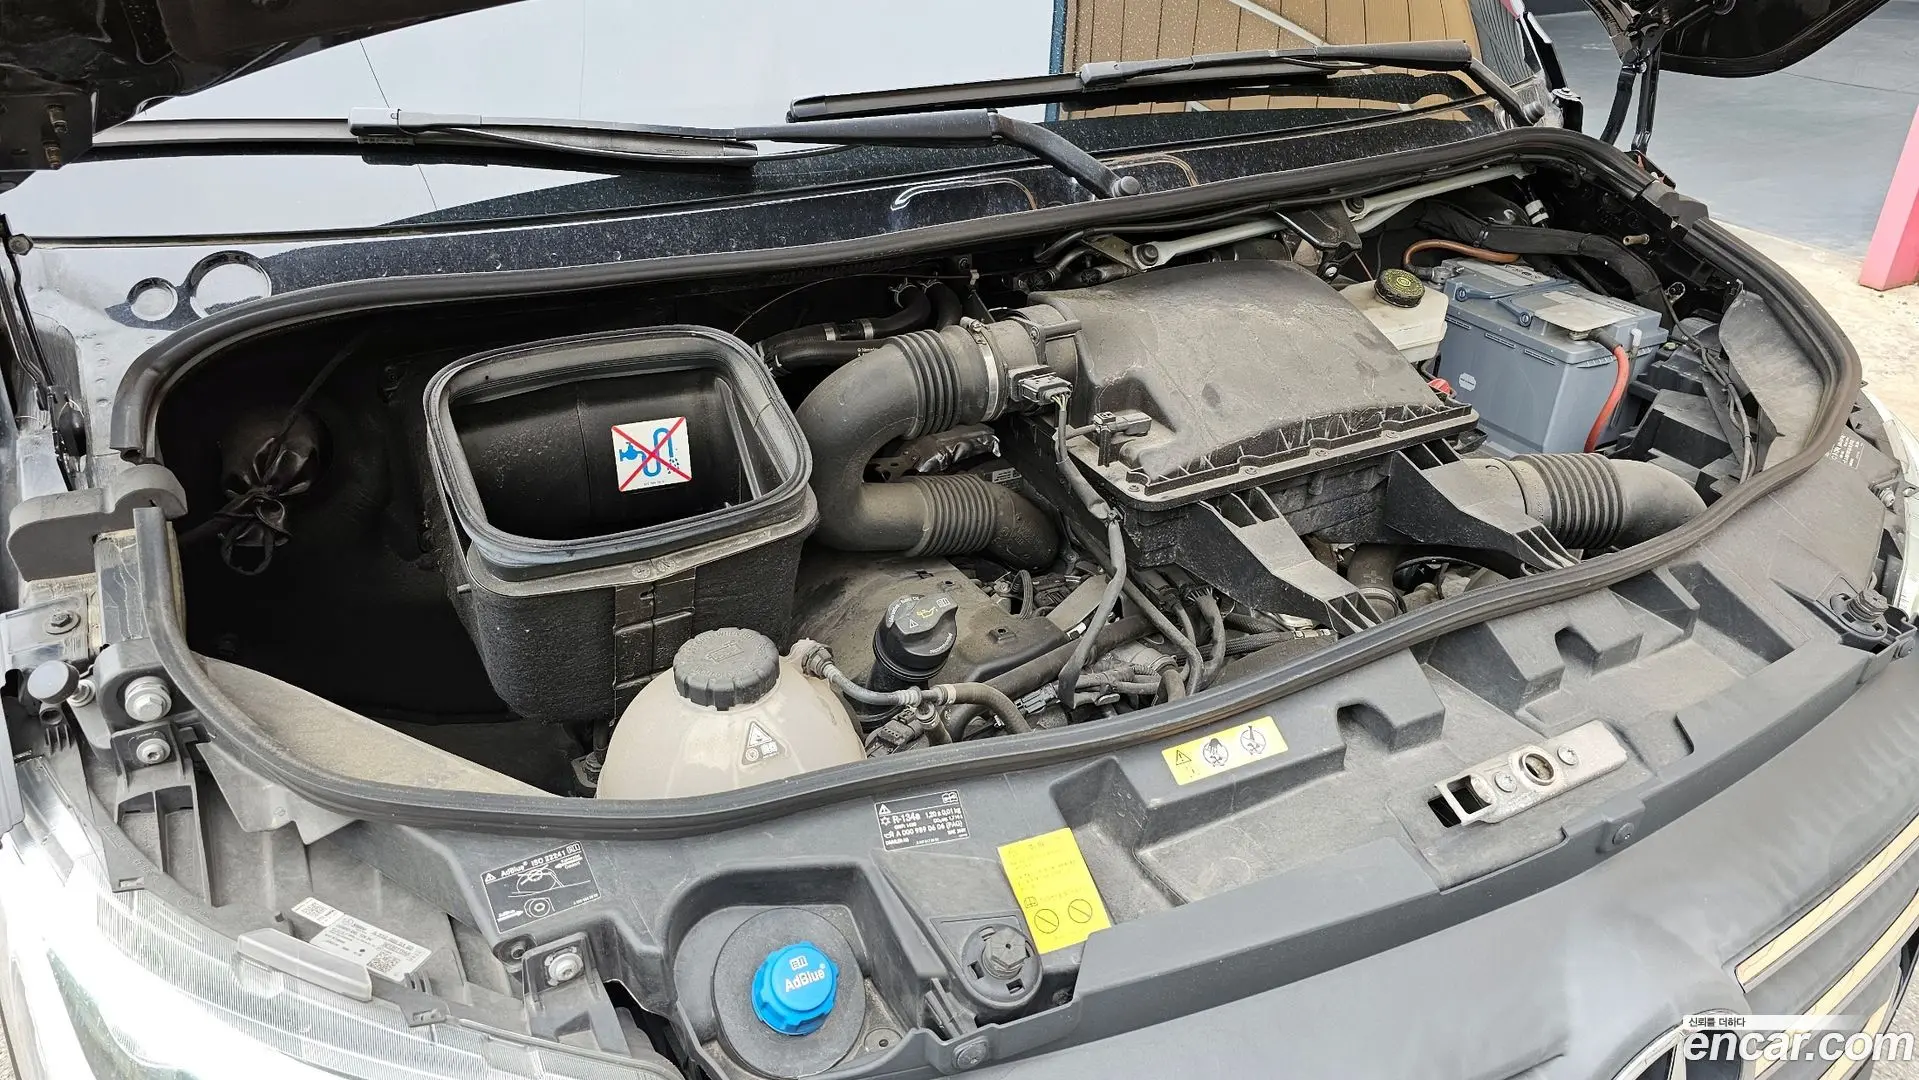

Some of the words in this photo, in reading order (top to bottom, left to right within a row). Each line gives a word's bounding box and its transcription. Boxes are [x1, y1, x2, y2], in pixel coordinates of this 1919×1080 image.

[892, 813, 921, 824] R-134a
[902, 828, 914, 836] 000
[531, 858, 544, 867] ISO
[545, 851, 566, 863] 22241
